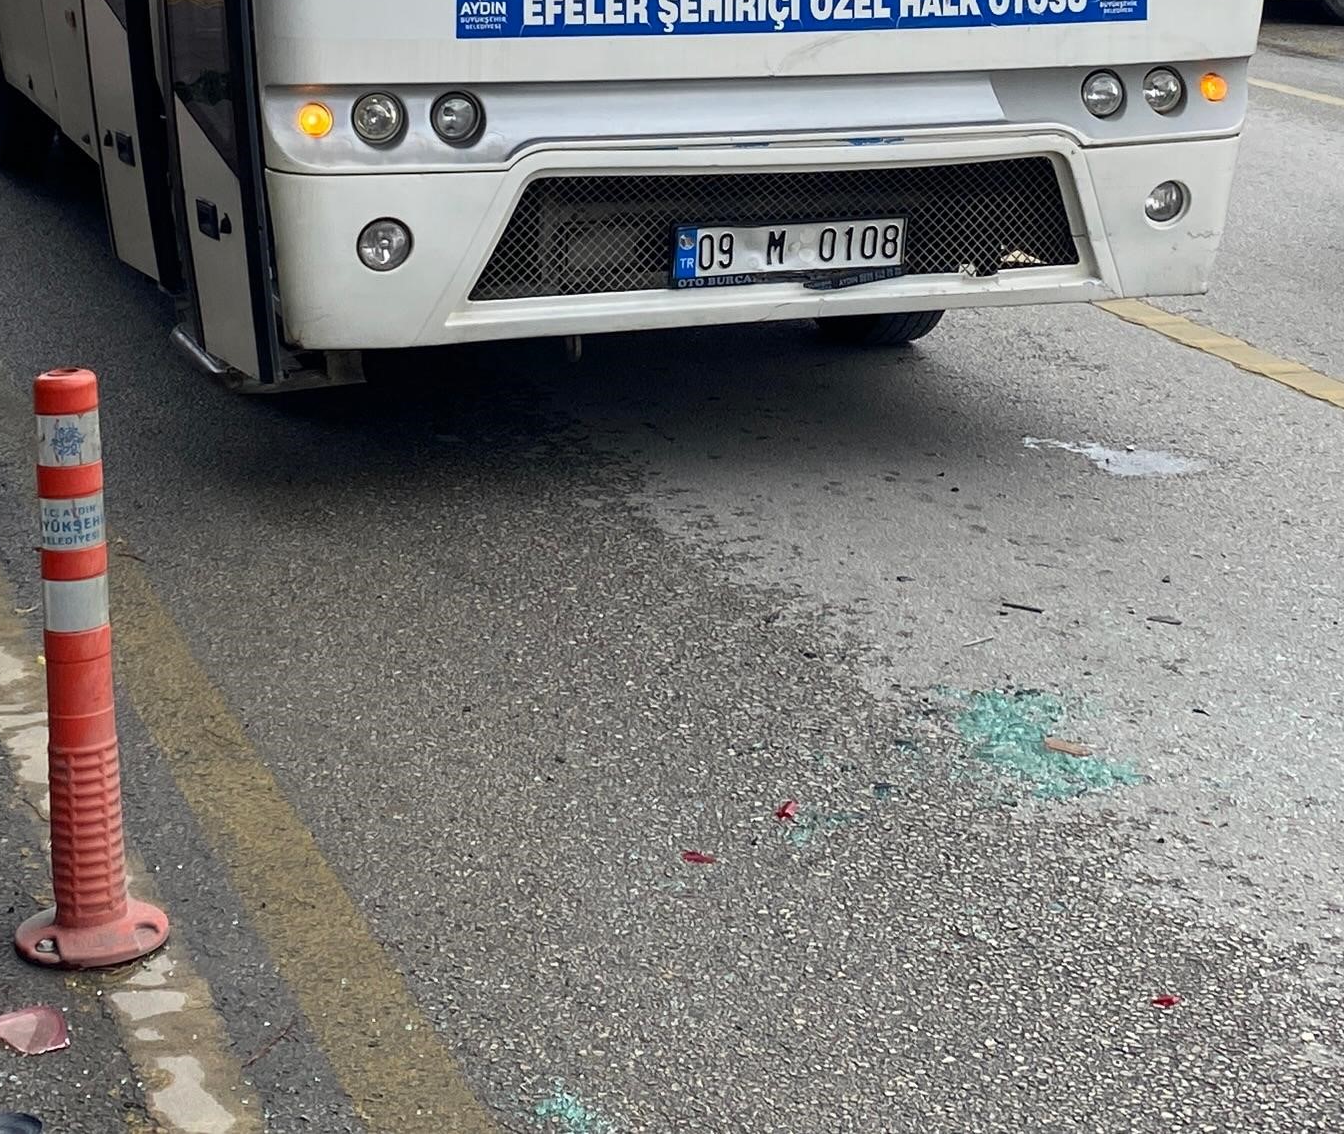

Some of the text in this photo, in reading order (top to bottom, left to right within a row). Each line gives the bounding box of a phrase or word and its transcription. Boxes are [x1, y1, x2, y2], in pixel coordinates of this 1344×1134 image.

[460, 1, 507, 16] AYDIN
[698, 224, 899, 271] 09 M 0108
[679, 257, 695, 270] TR
[678, 278, 705, 288] OTO
